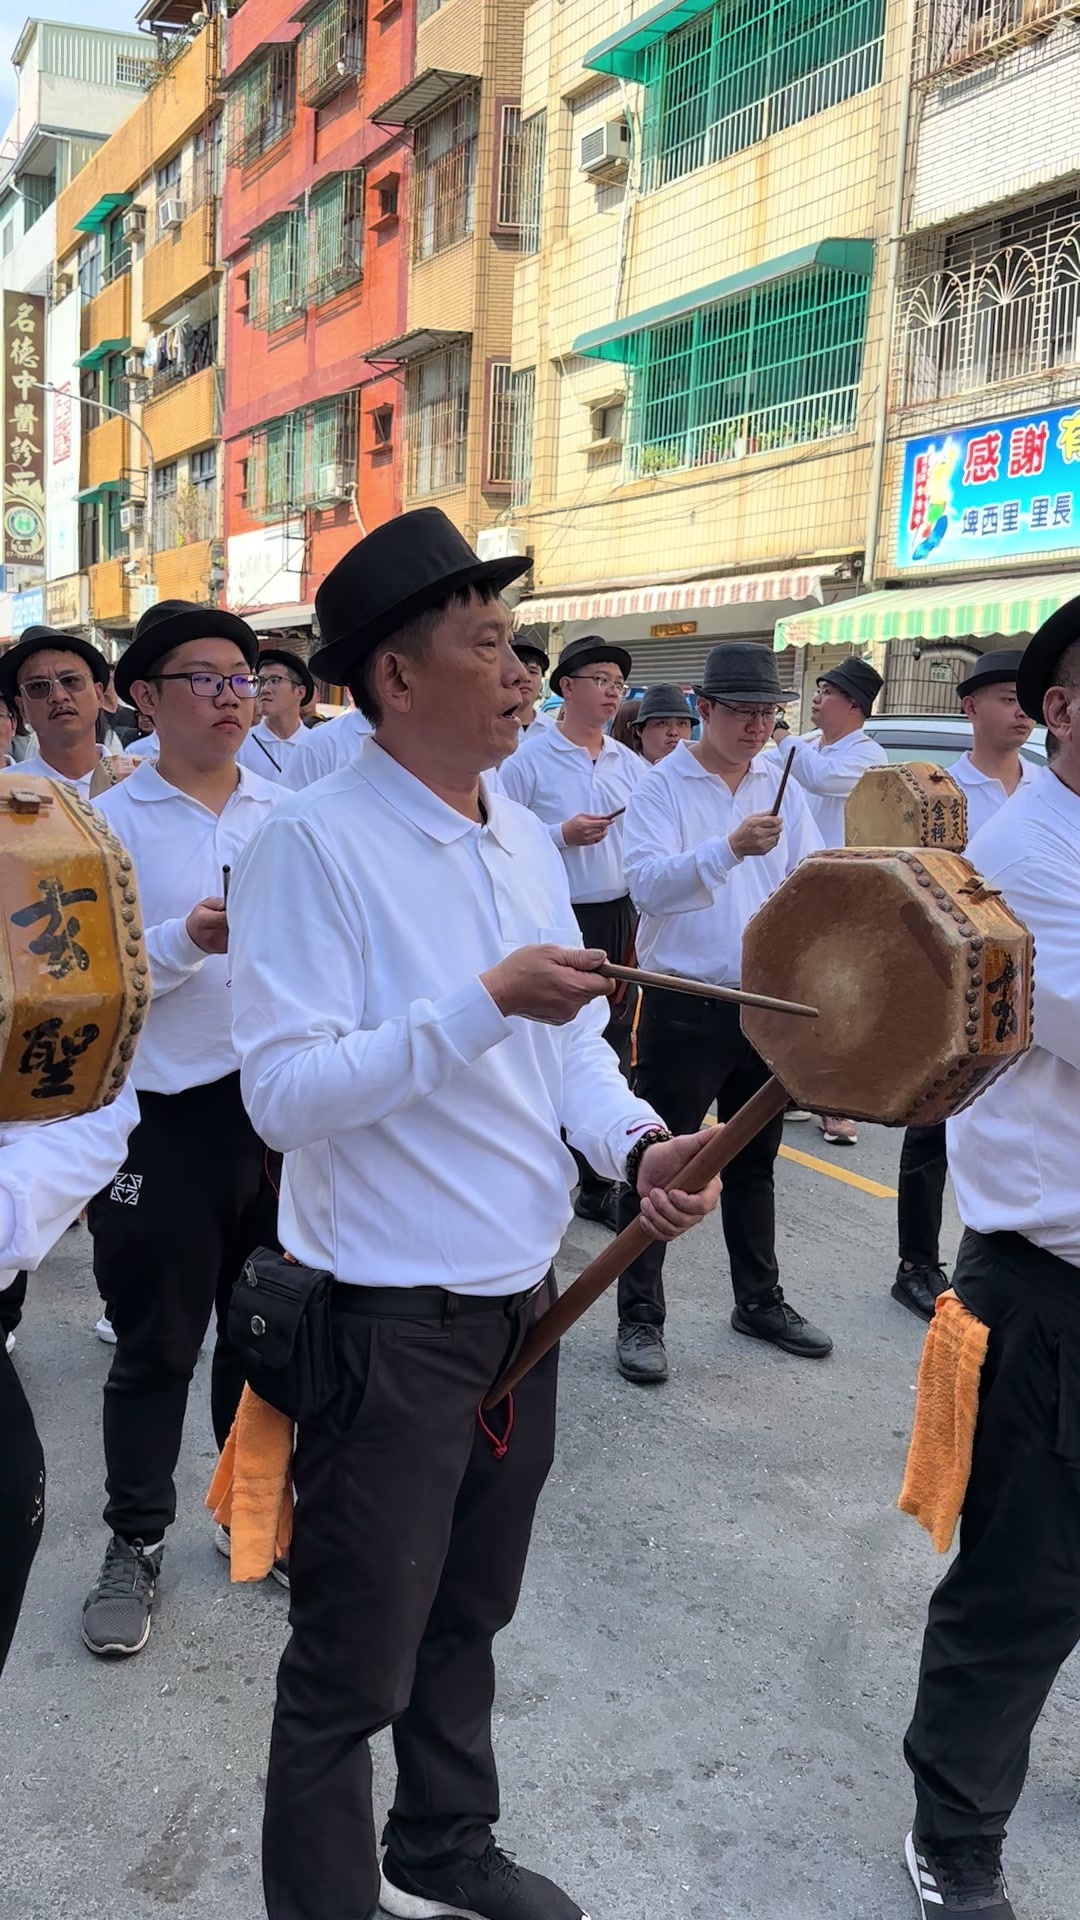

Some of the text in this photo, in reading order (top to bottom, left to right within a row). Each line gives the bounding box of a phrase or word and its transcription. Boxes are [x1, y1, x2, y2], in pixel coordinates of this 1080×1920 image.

[961, 494, 1071, 536] 埤西里 里長
